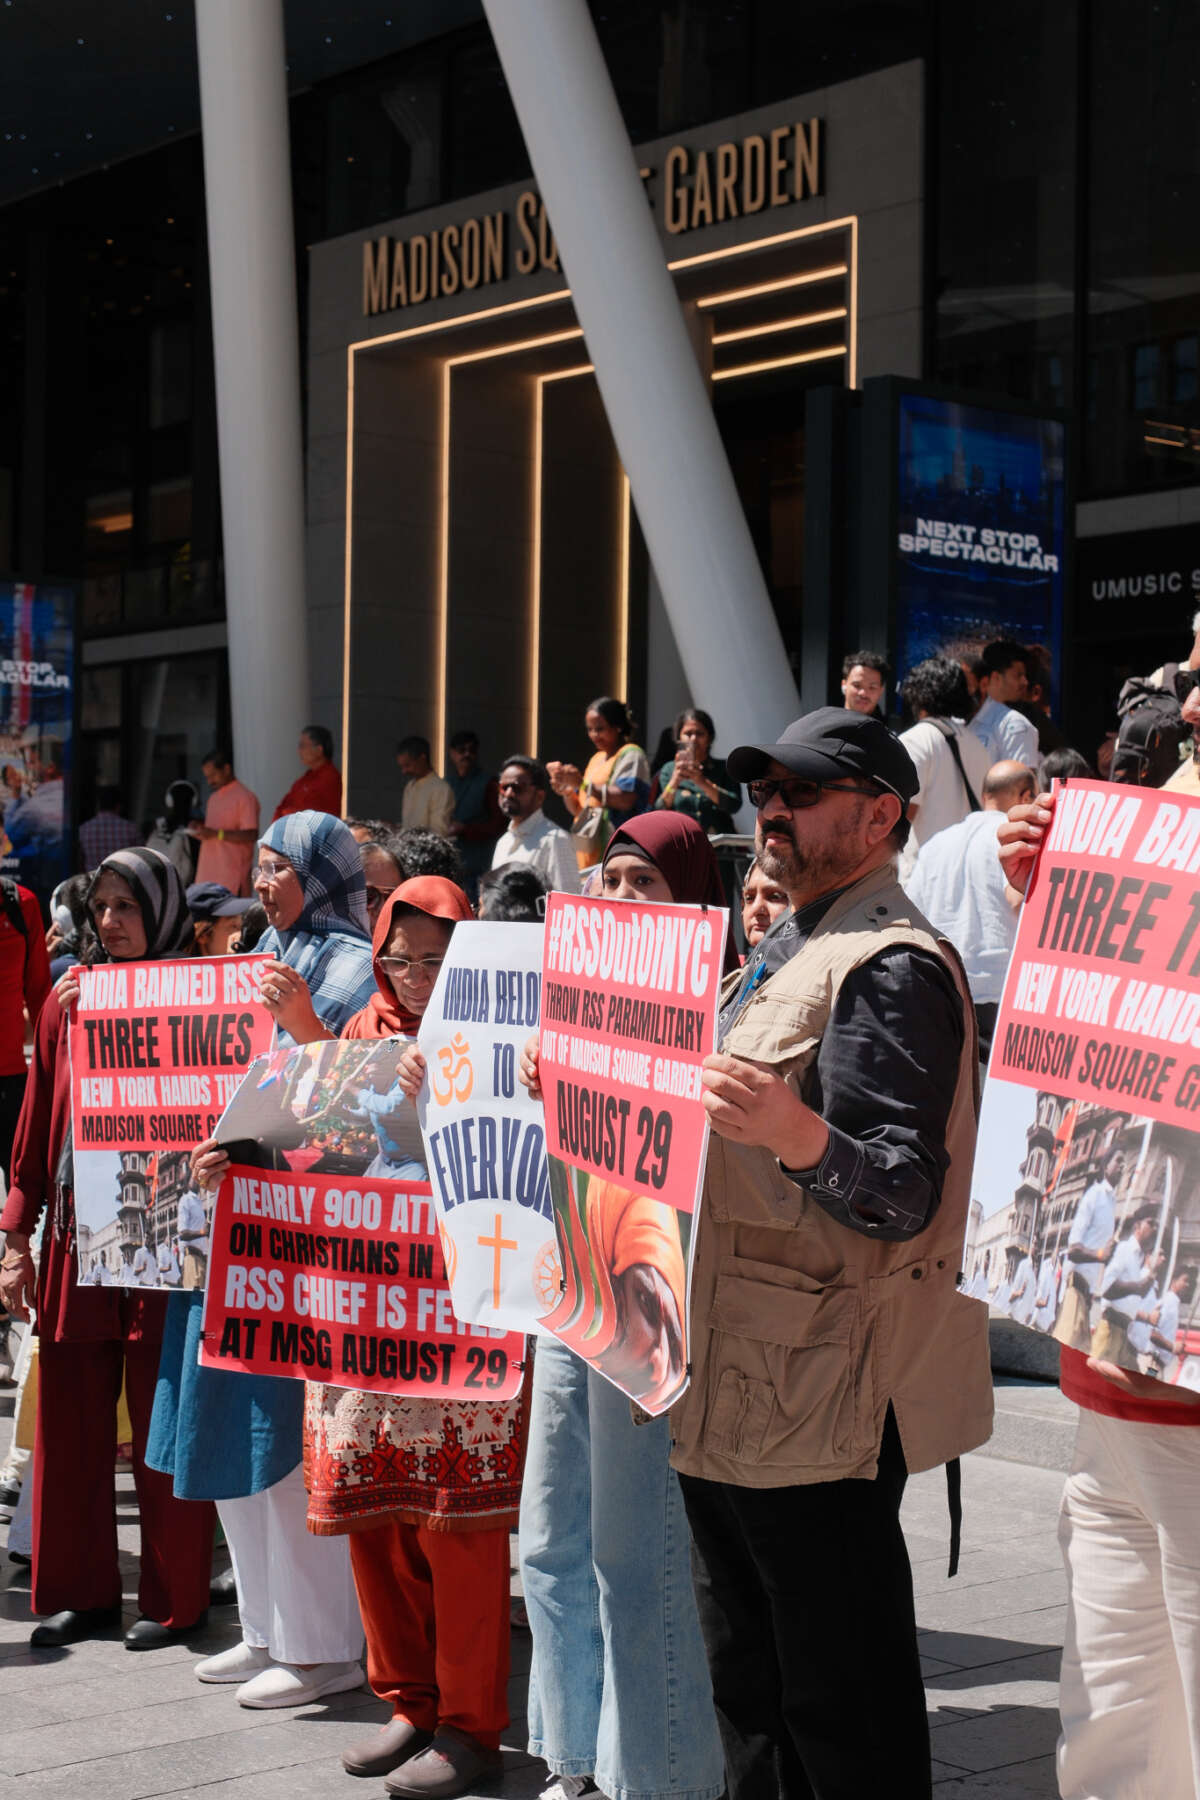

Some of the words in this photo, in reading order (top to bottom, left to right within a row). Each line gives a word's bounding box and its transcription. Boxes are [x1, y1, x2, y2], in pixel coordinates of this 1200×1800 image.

[363, 212, 503, 316] MADISON
[664, 117, 820, 234] GARDEN
[898, 534, 1059, 573] SPECTACULAR
[916, 518, 976, 543] NEXT
[981, 528, 1043, 554] STOP,
[1092, 571, 1182, 600] UMUSIC
[1048, 788, 1142, 859] INDIA
[1038, 867, 1172, 965] THREE
[548, 903, 712, 998] #RSSOutOfNYC
[77, 968, 127, 1011] INDIA
[134, 964, 216, 1009] BANNED
[223, 961, 265, 1004] RSS
[443, 967, 489, 1023] INDIA
[1013, 961, 1057, 1016] NEW
[1055, 967, 1120, 1027] YORK
[84, 1016, 160, 1069] THREE
[168, 1013, 254, 1067] TIMES
[545, 981, 581, 1025] THROW
[581, 989, 604, 1031] RSS
[605, 995, 705, 1054] PARAMILITARY
[81, 1077, 113, 1108] NEW
[118, 1076, 158, 1107] YORK
[160, 1075, 211, 1106] HANDS
[493, 1042, 514, 1099] TO
[542, 1029, 557, 1063] OUT
[558, 1034, 568, 1067] OF
[569, 1036, 611, 1079] MADISON
[612, 1047, 651, 1090] SQUARE
[653, 1058, 703, 1102] GARDEN
[1003, 1023, 1079, 1081] MADISON
[1078, 1038, 1177, 1103] SQUARE
[82, 1115, 144, 1142] MADISON
[150, 1113, 203, 1142] SQUARE
[557, 1079, 631, 1177] AUGUST
[634, 1105, 673, 1190] 29
[233, 1176, 316, 1225] NEARLY
[324, 1188, 382, 1231] 900
[230, 1222, 262, 1258] ON
[269, 1227, 399, 1275] CHRISTIANS
[409, 1243, 433, 1279] IN
[225, 1265, 284, 1312] RSS
[294, 1272, 366, 1326] CHIEF
[377, 1284, 406, 1330] IS
[219, 1317, 260, 1360] AT
[270, 1321, 332, 1370] MSG
[342, 1334, 456, 1386] AUGUST
[464, 1347, 507, 1390] 29
